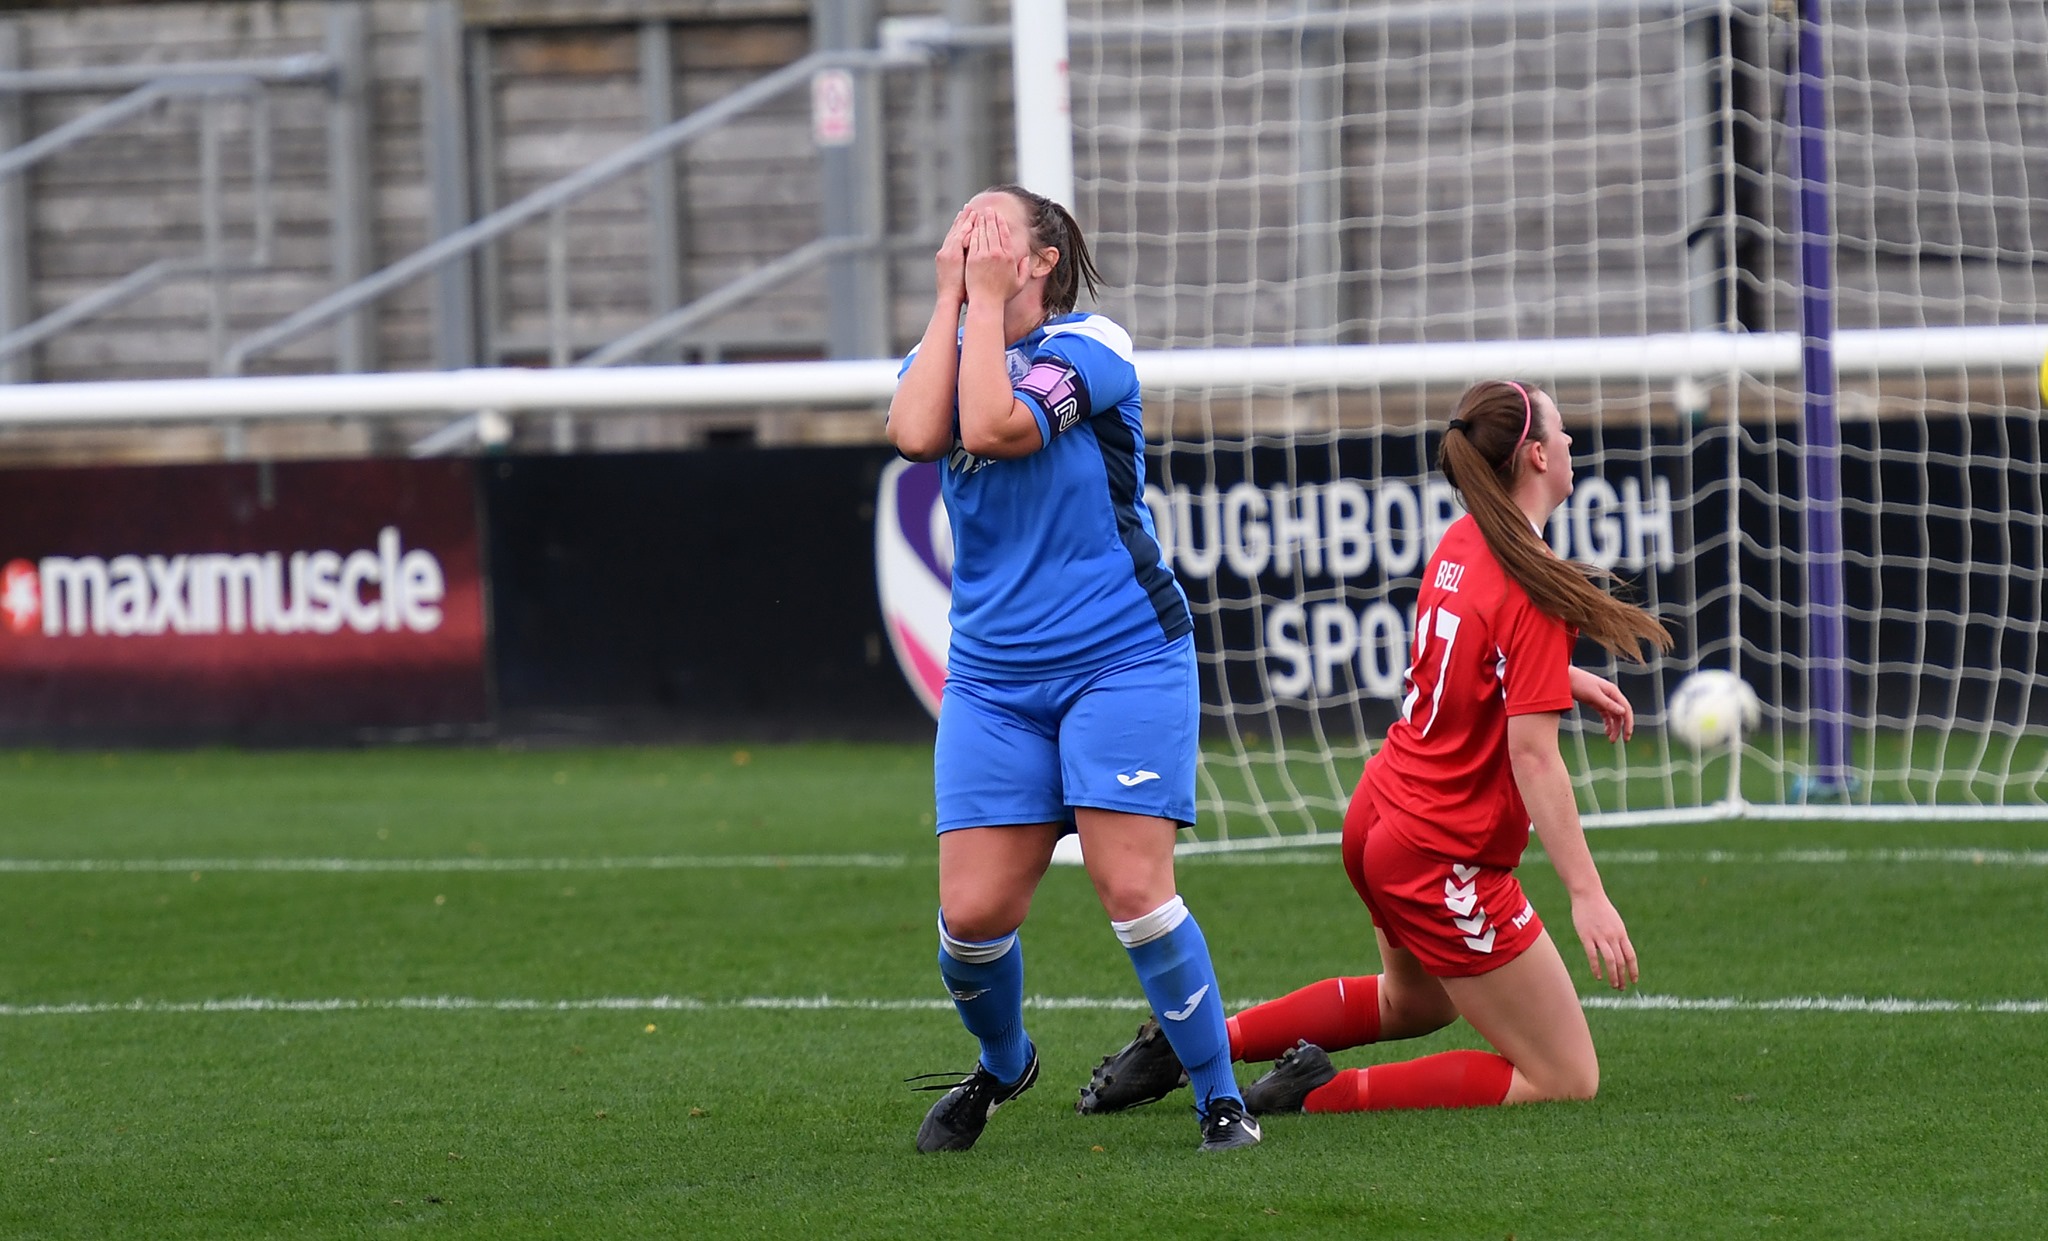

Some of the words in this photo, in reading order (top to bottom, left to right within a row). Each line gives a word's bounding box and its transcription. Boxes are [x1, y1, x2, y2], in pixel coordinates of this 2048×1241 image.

[40, 525, 445, 636] maximuscle
[1434, 560, 1465, 592] BELL
[1265, 601, 1416, 699] SPO
[1402, 606, 1462, 736] 17
